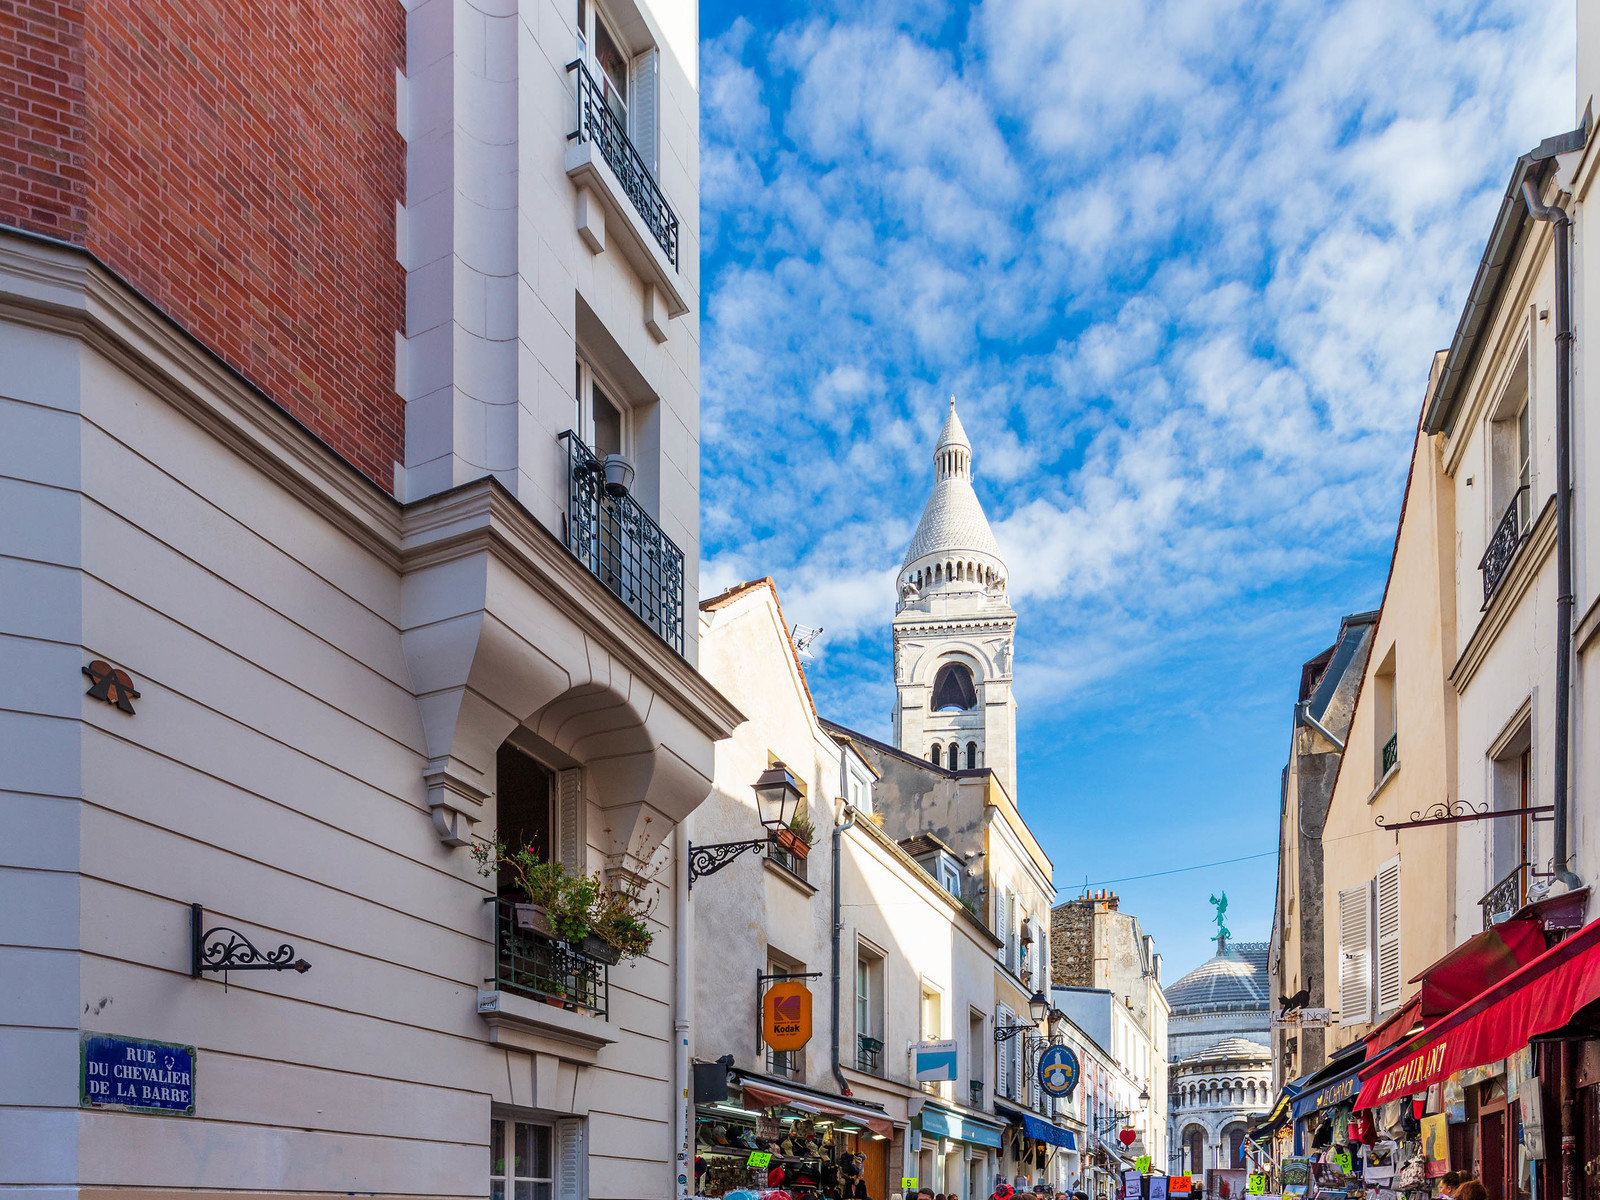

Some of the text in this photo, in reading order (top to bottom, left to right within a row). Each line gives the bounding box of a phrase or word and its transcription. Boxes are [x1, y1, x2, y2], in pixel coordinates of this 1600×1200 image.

[774, 1024, 800, 1033] Kodak
[126, 1047, 156, 1064] RUE
[88, 1061, 191, 1086] DU CHEVALIER
[1378, 1042, 1447, 1099] RESTAURANT
[89, 1080, 189, 1103] DE LA BARRE
